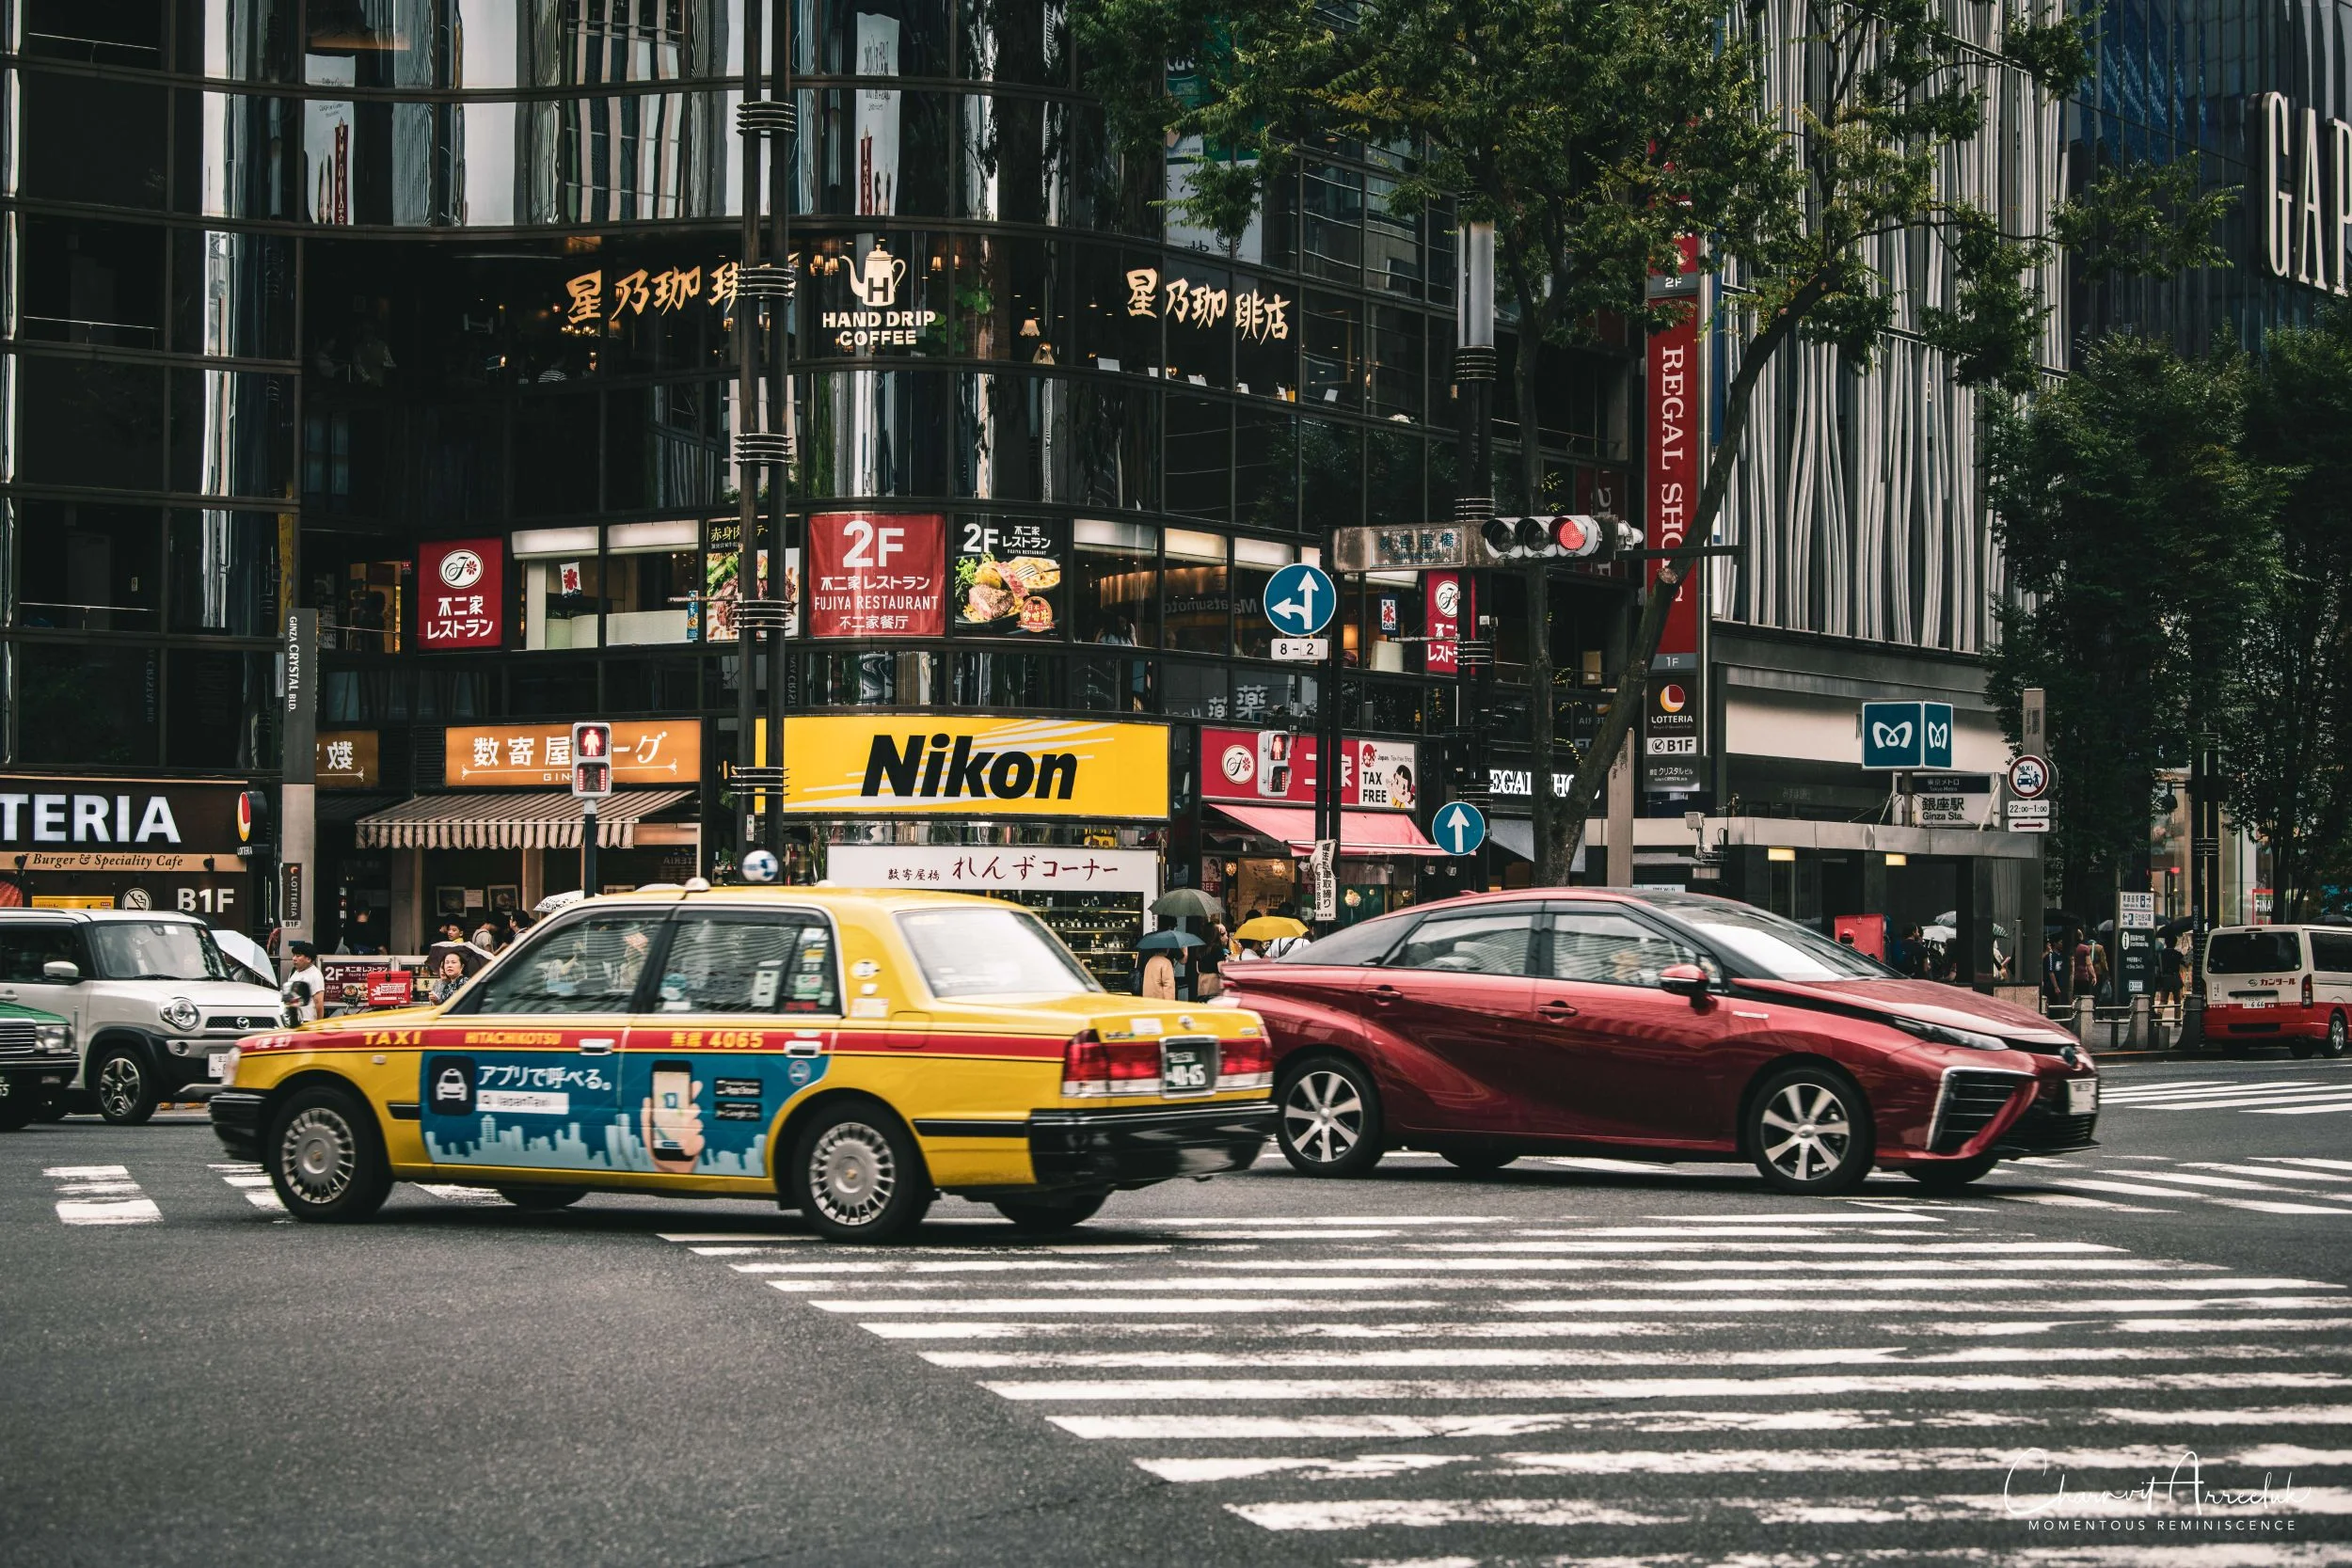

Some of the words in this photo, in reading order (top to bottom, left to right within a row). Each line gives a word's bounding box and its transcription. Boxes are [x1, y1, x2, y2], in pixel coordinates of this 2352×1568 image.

[2268, 91, 2352, 297] GAP
[1664, 277, 1682, 288] 2F
[1126, 267, 1292, 345] 星乃珈琲店
[822, 312, 882, 327] HAND
[886, 310, 936, 326] DRIP
[839, 330, 917, 346] COFFEE
[1661, 344, 1684, 470] REGAL
[843, 520, 904, 567] 2F
[962, 523, 999, 553] 2F
[1002, 535, 1051, 549] レストラン
[820, 575, 930, 591] 不二家レストラン
[437, 595, 484, 616] 不二家
[815, 596, 851, 610] FUJIYA
[856, 595, 939, 610] RESTAURANT
[289, 616, 297, 641] GINZA
[427, 619, 493, 640] レストラン
[839, 615, 909, 629] 不二家餐厅
[288, 645, 300, 690] CRYSTAL
[1665, 657, 1679, 667] 1F
[288, 693, 297, 712] BLD.
[1651, 715, 1693, 724] LOTTERIA
[1667, 739, 1693, 752] B1F
[861, 733, 1078, 800] Nikon
[1362, 772, 1382, 785] TAX
[1362, 789, 1387, 803] FREE
[1922, 798, 1964, 811] 銀座駅
[2010, 804, 2047, 814] 22:00-1:00
[1923, 812, 1947, 821] Ginza
[1948, 812, 1963, 821] Sta.
[237, 846, 253, 855] LOTTERIA
[33, 853, 75, 869] Burger
[79, 853, 91, 864] &
[94, 854, 152, 870] Speciality
[156, 855, 183, 867] Cafe
[953, 855, 1119, 881] れんずコーナー
[888, 869, 940, 881] 数寄屋橋
[178, 889, 233, 912] B1F
[325, 967, 344, 981] 2F
[363, 1031, 421, 1046] TAXI
[708, 1032, 764, 1048] 4065
[478, 1066, 612, 1090] アプリで呼べる。
